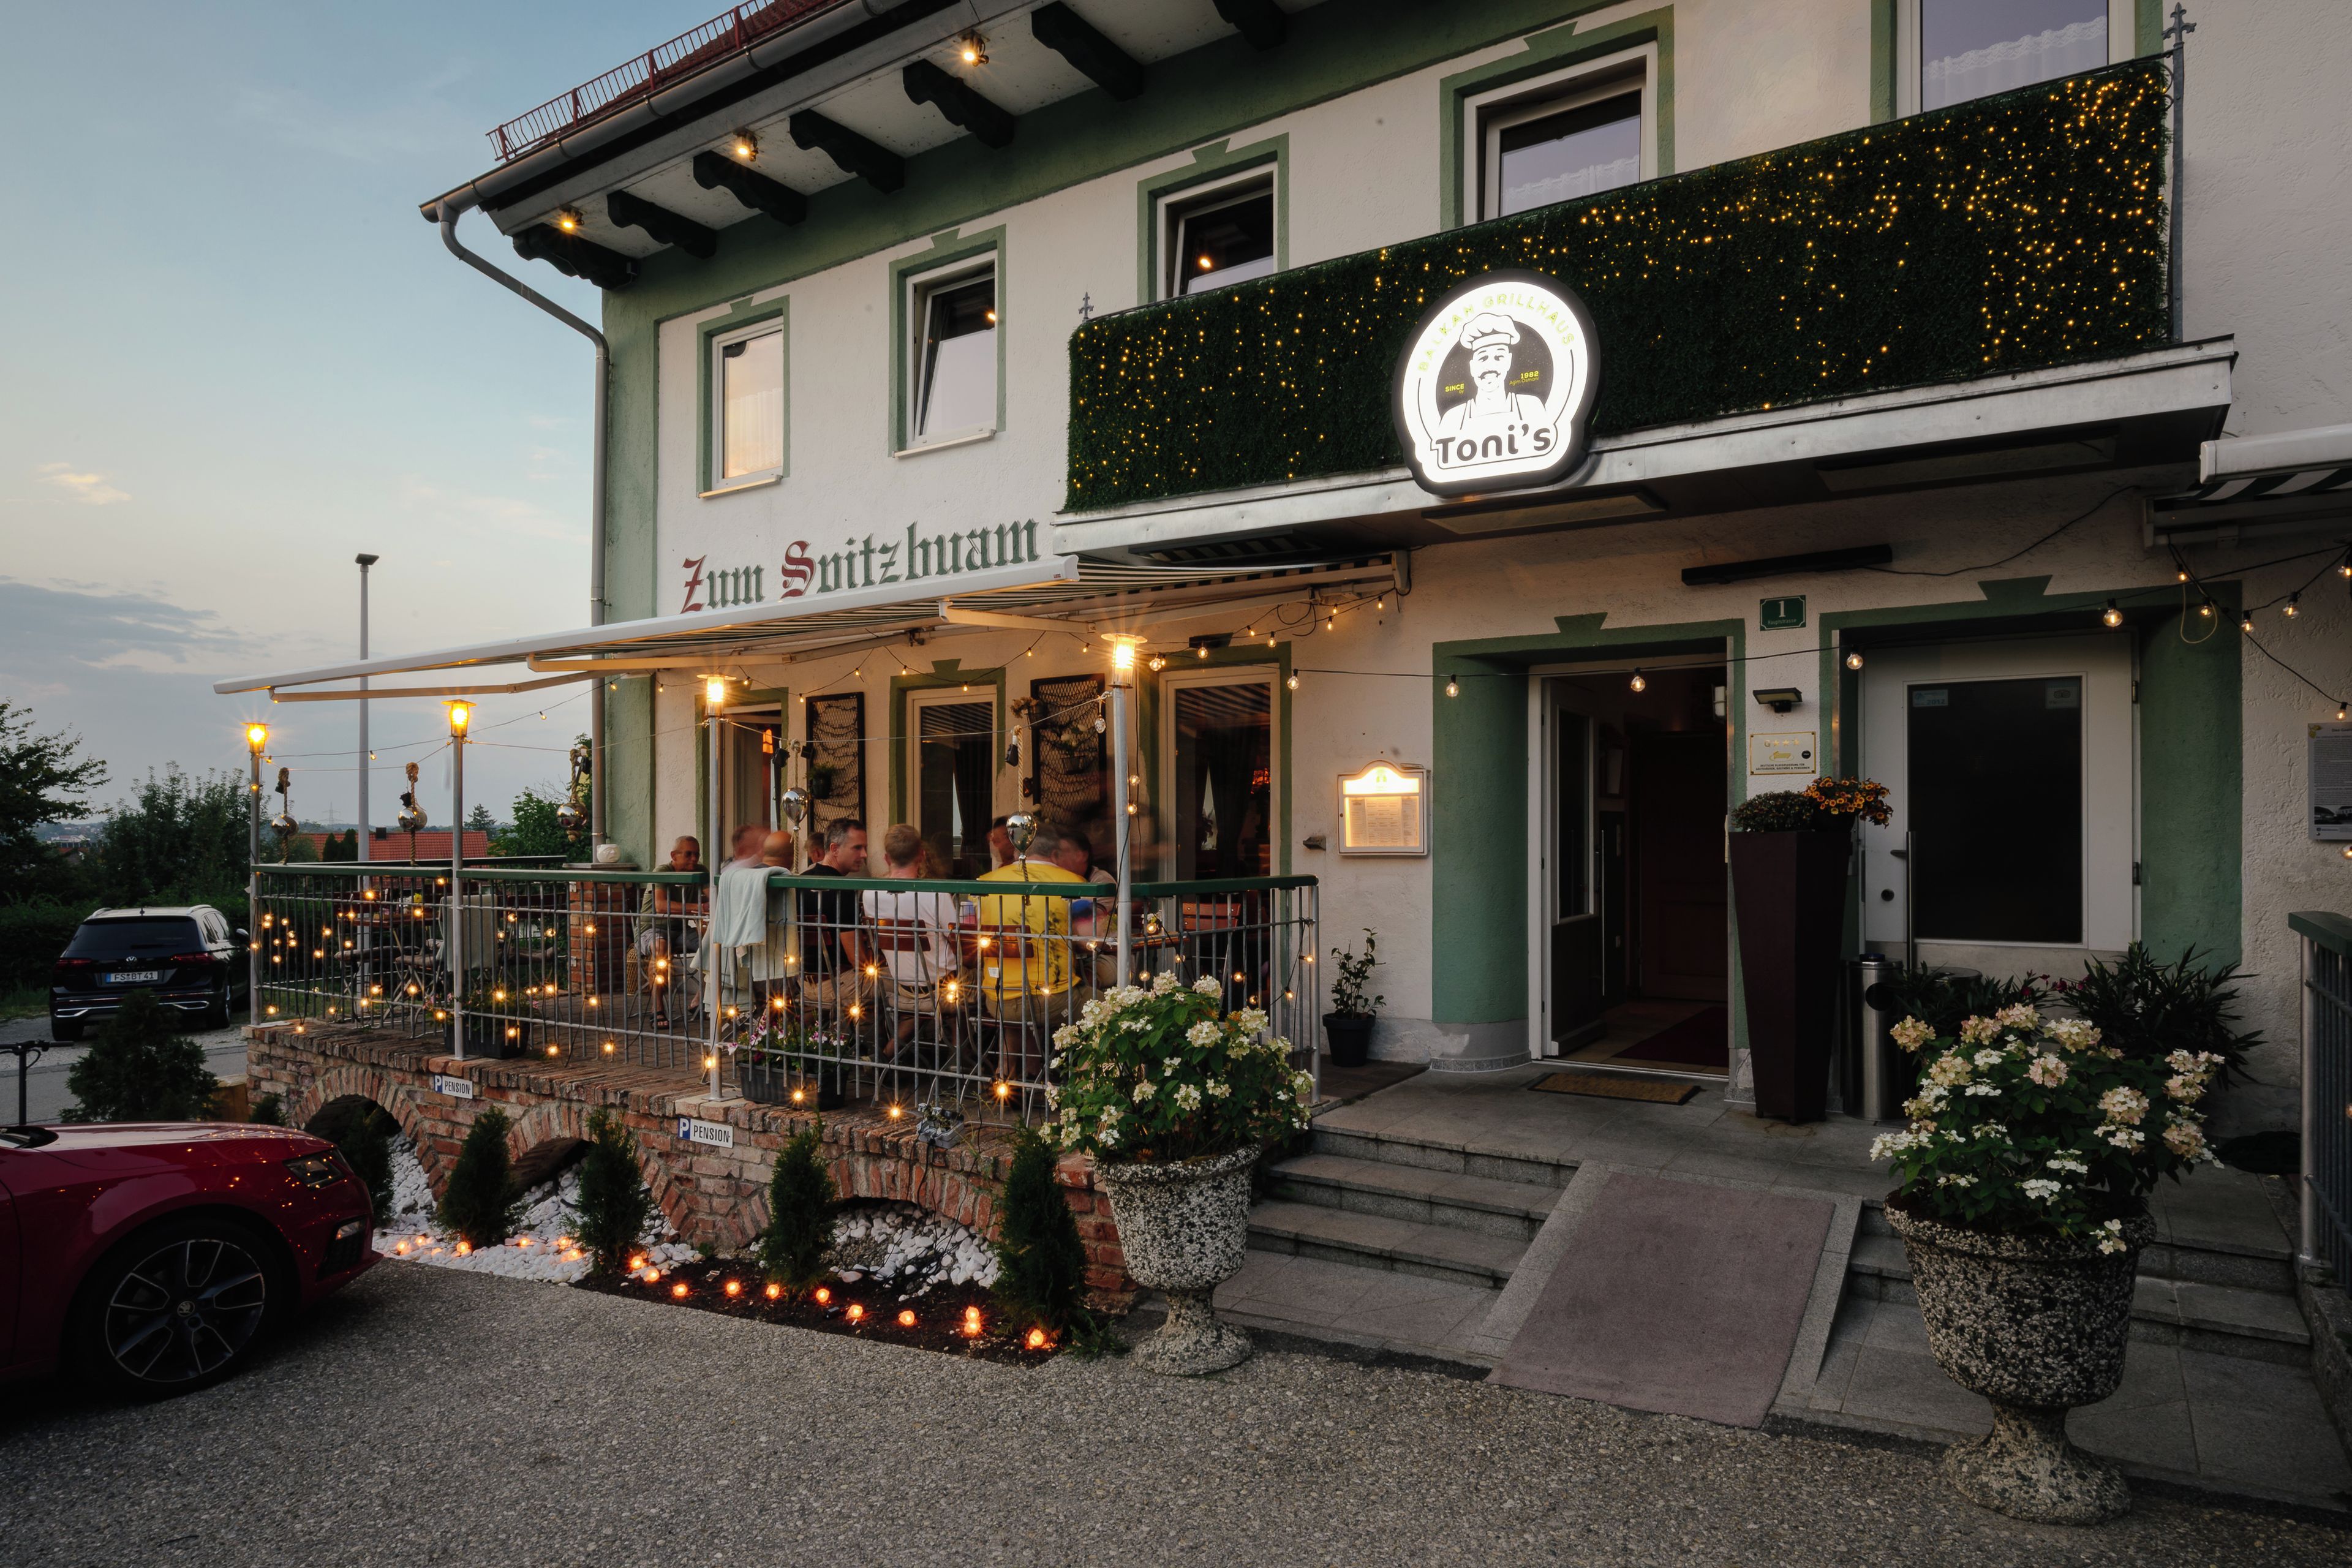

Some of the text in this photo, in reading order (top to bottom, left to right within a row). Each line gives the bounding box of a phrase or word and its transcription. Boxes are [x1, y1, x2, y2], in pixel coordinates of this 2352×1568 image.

[1418, 293, 1575, 372] BALKAN GRILLHAUS
[1445, 371, 1539, 393] SINCE 1982
[681, 554, 765, 614] Zum
[1779, 600, 1786, 617] 1
[445, 1080, 470, 1095] PENSION
[694, 1125, 729, 1143] PENSION
